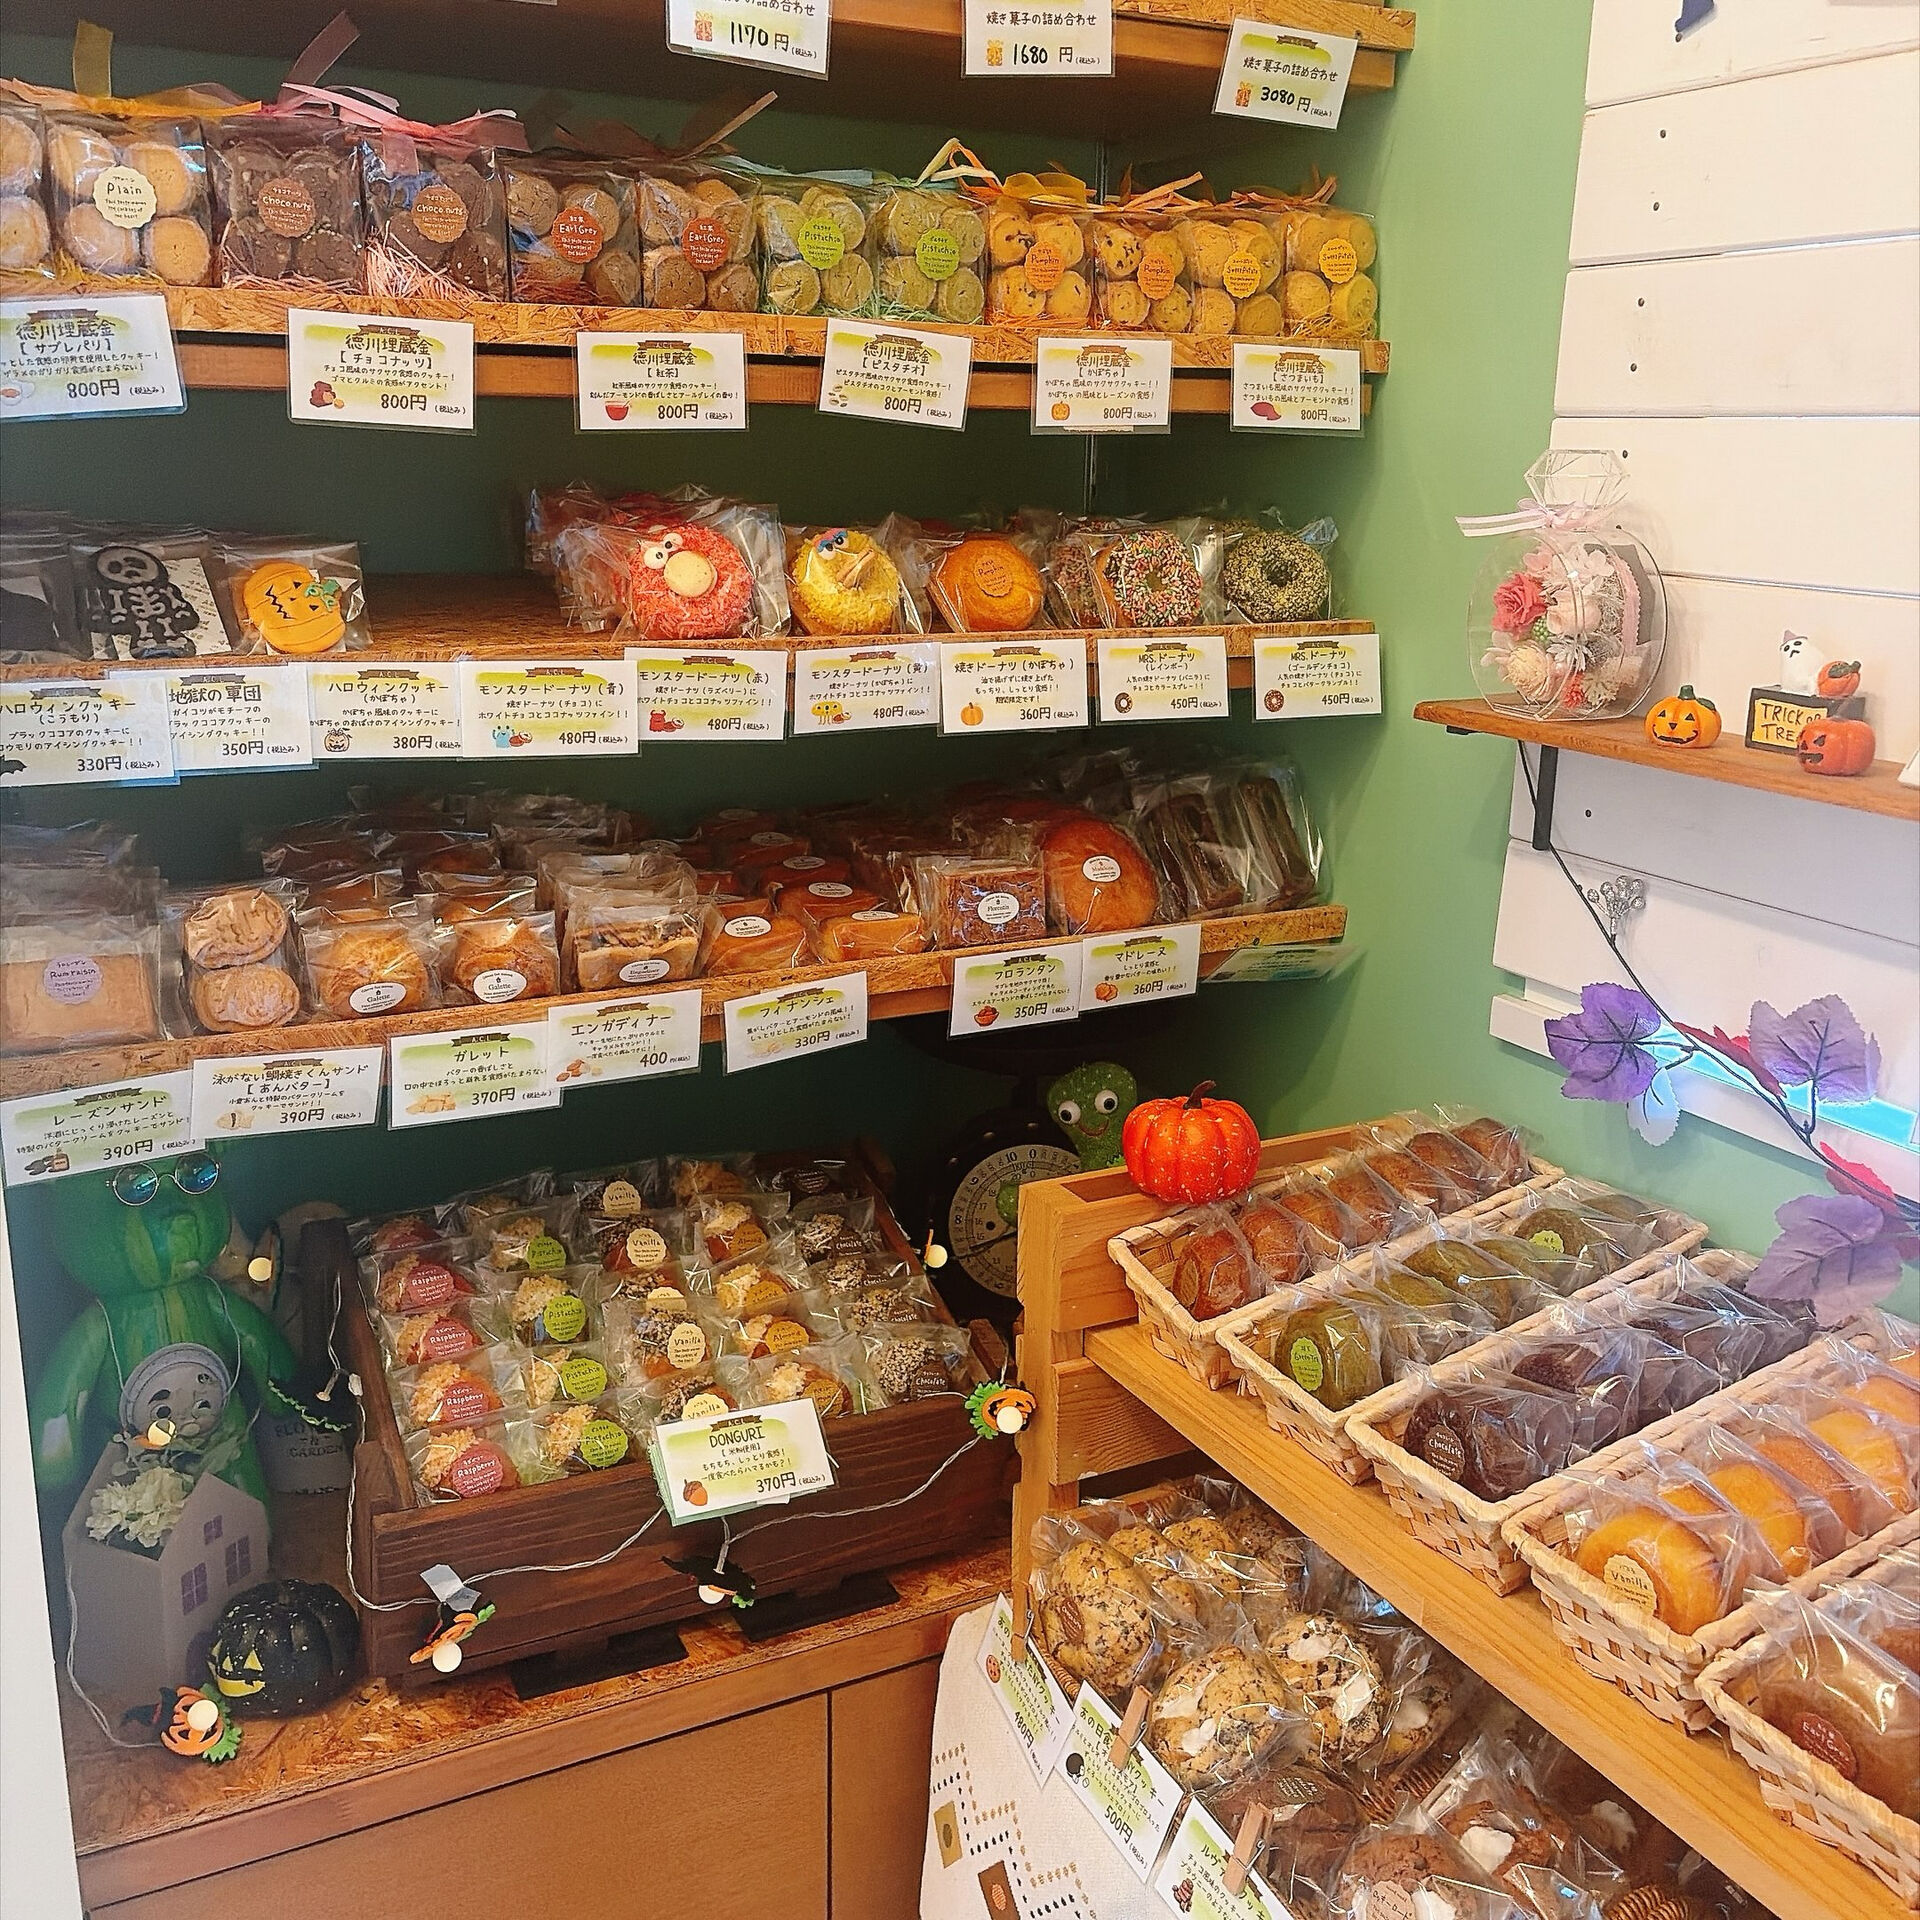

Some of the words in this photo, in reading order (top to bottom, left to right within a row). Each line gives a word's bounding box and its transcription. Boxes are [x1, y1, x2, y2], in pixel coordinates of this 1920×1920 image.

[986, 11, 1097, 27] 焼き菓子の詰め合わせ
[1243, 56, 1338, 82] 焼き菓子の詰め合わせ
[107, 183, 142, 195] Plain
[16, 318, 116, 341] 徳川埋蔵金
[346, 334, 433, 356] 徳川埋蔵金
[863, 342, 932, 364] 徳川埋蔵金
[633, 351, 697, 366] 徳川埋蔵金
[1076, 354, 1133, 368] 徳川埋蔵金
[67, 378, 120, 399] 800円
[381, 394, 427, 411] 800円
[884, 396, 921, 414] 800円
[658, 403, 698, 419] 800円
[329, 681, 449, 694] ハロウィンクッキー
[1170, 696, 1198, 709] 450円
[1322, 693, 1350, 705] 450円
[873, 705, 903, 719] 480円
[1020, 707, 1051, 720] 360円
[1761, 703, 1804, 725] TRICK
[707, 718, 741, 731] 480円
[558, 731, 596, 745] 480円
[1761, 723, 1801, 743] TRE
[222, 740, 264, 756] 350円
[393, 735, 433, 749] 380円
[77, 755, 122, 772] 330円
[1115, 946, 1167, 962] マドレーヌ
[994, 964, 1056, 980] フロランタン
[1133, 980, 1163, 995] 360円
[760, 995, 835, 1018] フィナンシェ
[1014, 1002, 1048, 1018] 350円
[571, 1013, 672, 1037] エンガディナー
[795, 1030, 831, 1049] 330円
[454, 1046, 509, 1062] ガレット
[640, 1052, 668, 1067] 400
[472, 1087, 516, 1105] 370円
[53, 1095, 167, 1126] レーズンサンド
[279, 1108, 325, 1124] 390円
[103, 1139, 153, 1161] 390円
[709, 1426, 766, 1448] DONGURI
[756, 1472, 796, 1493] 370円
[1104, 1805, 1133, 1844] 500円
